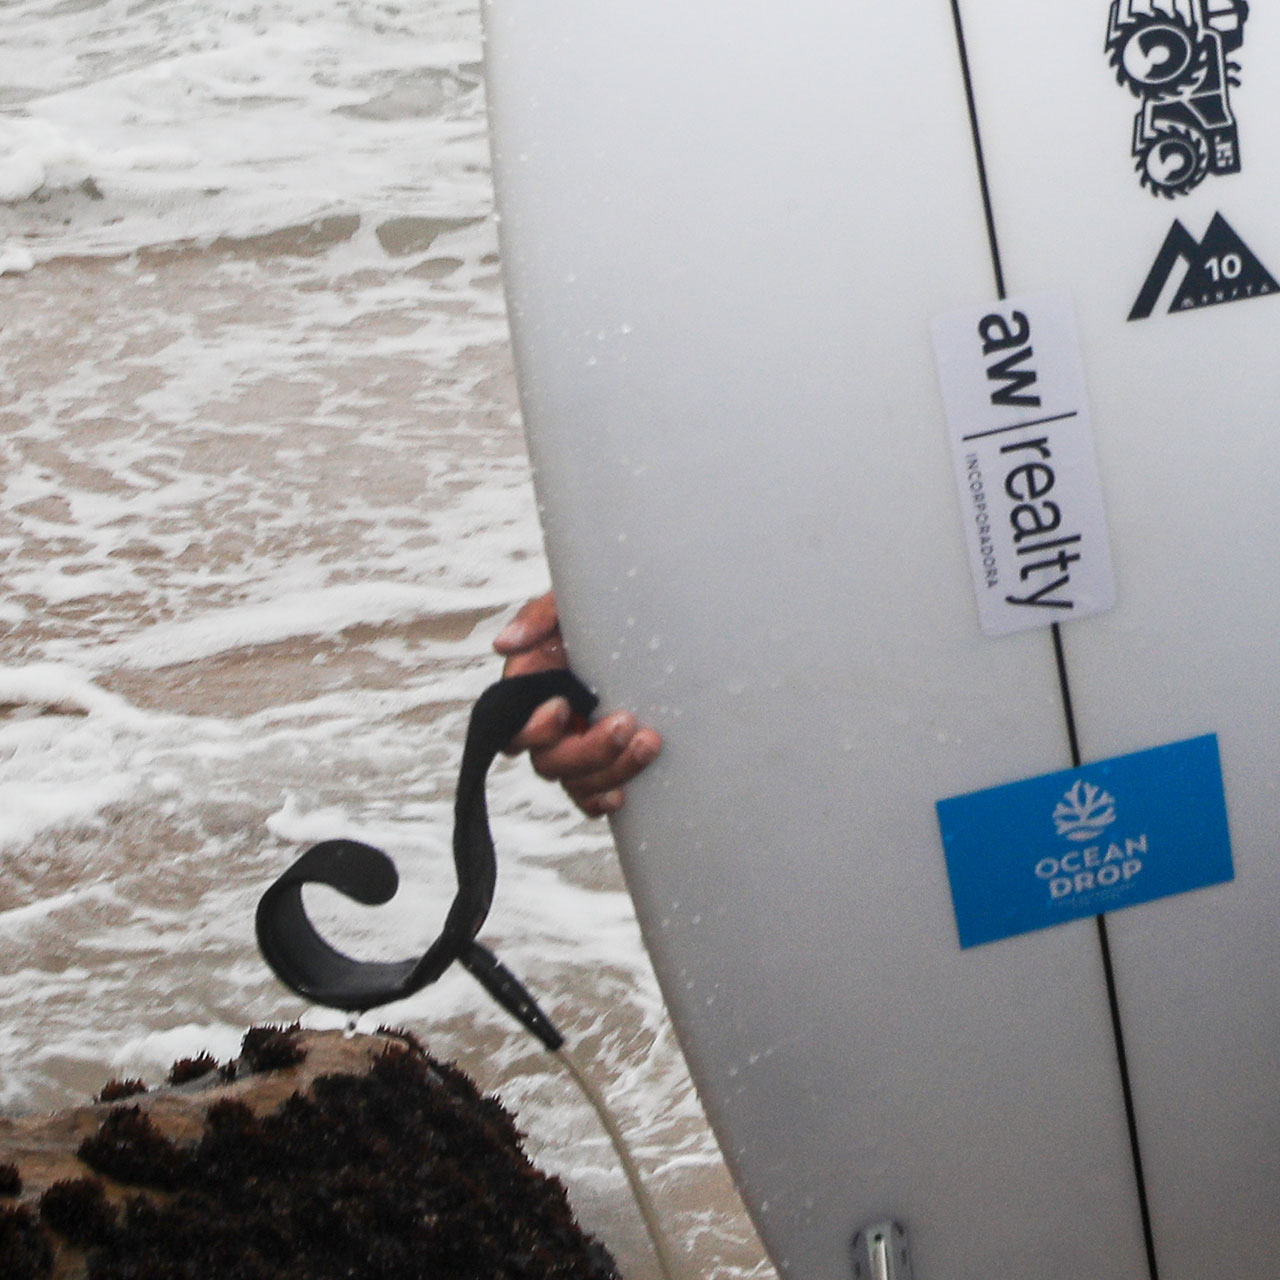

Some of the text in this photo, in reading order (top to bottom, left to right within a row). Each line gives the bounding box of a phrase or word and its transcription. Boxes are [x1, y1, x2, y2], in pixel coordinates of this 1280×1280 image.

[1204, 253, 1243, 282] 10
[977, 309, 1082, 609] aw realty
[964, 452, 998, 590] INCORPORADORA
[1034, 833, 1149, 879] OCEAN
[1049, 857, 1143, 899] DROP
